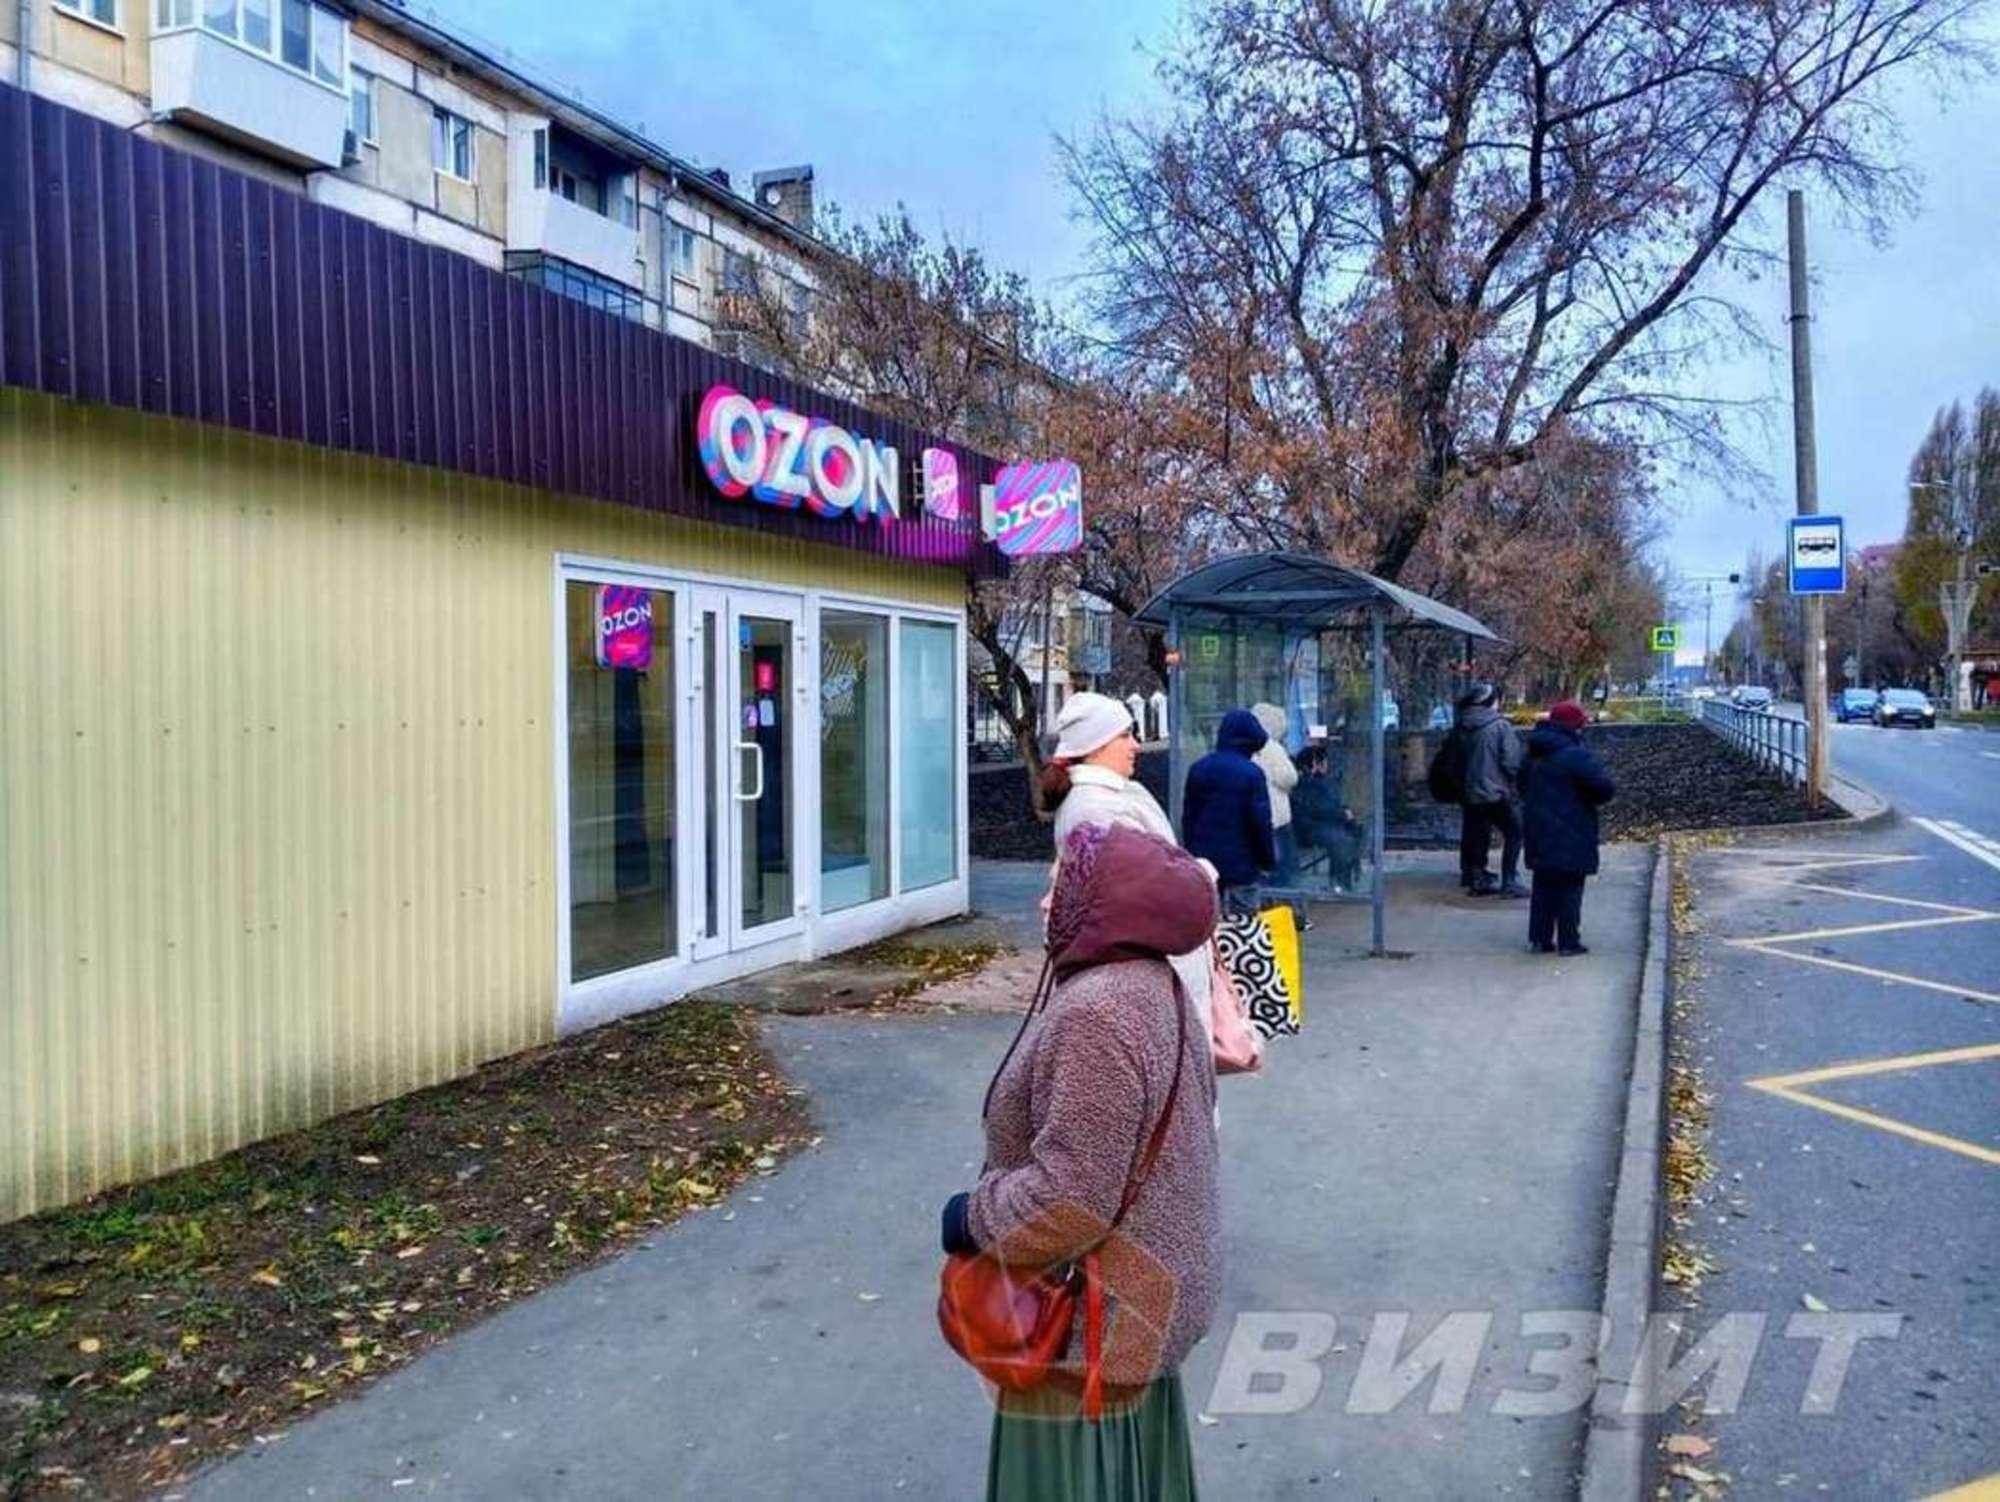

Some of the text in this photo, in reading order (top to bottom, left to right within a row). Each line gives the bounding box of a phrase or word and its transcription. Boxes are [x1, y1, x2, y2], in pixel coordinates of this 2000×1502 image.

[699, 387, 901, 526] OZON
[995, 482, 1077, 533] OZON
[600, 601, 652, 636] OZON
